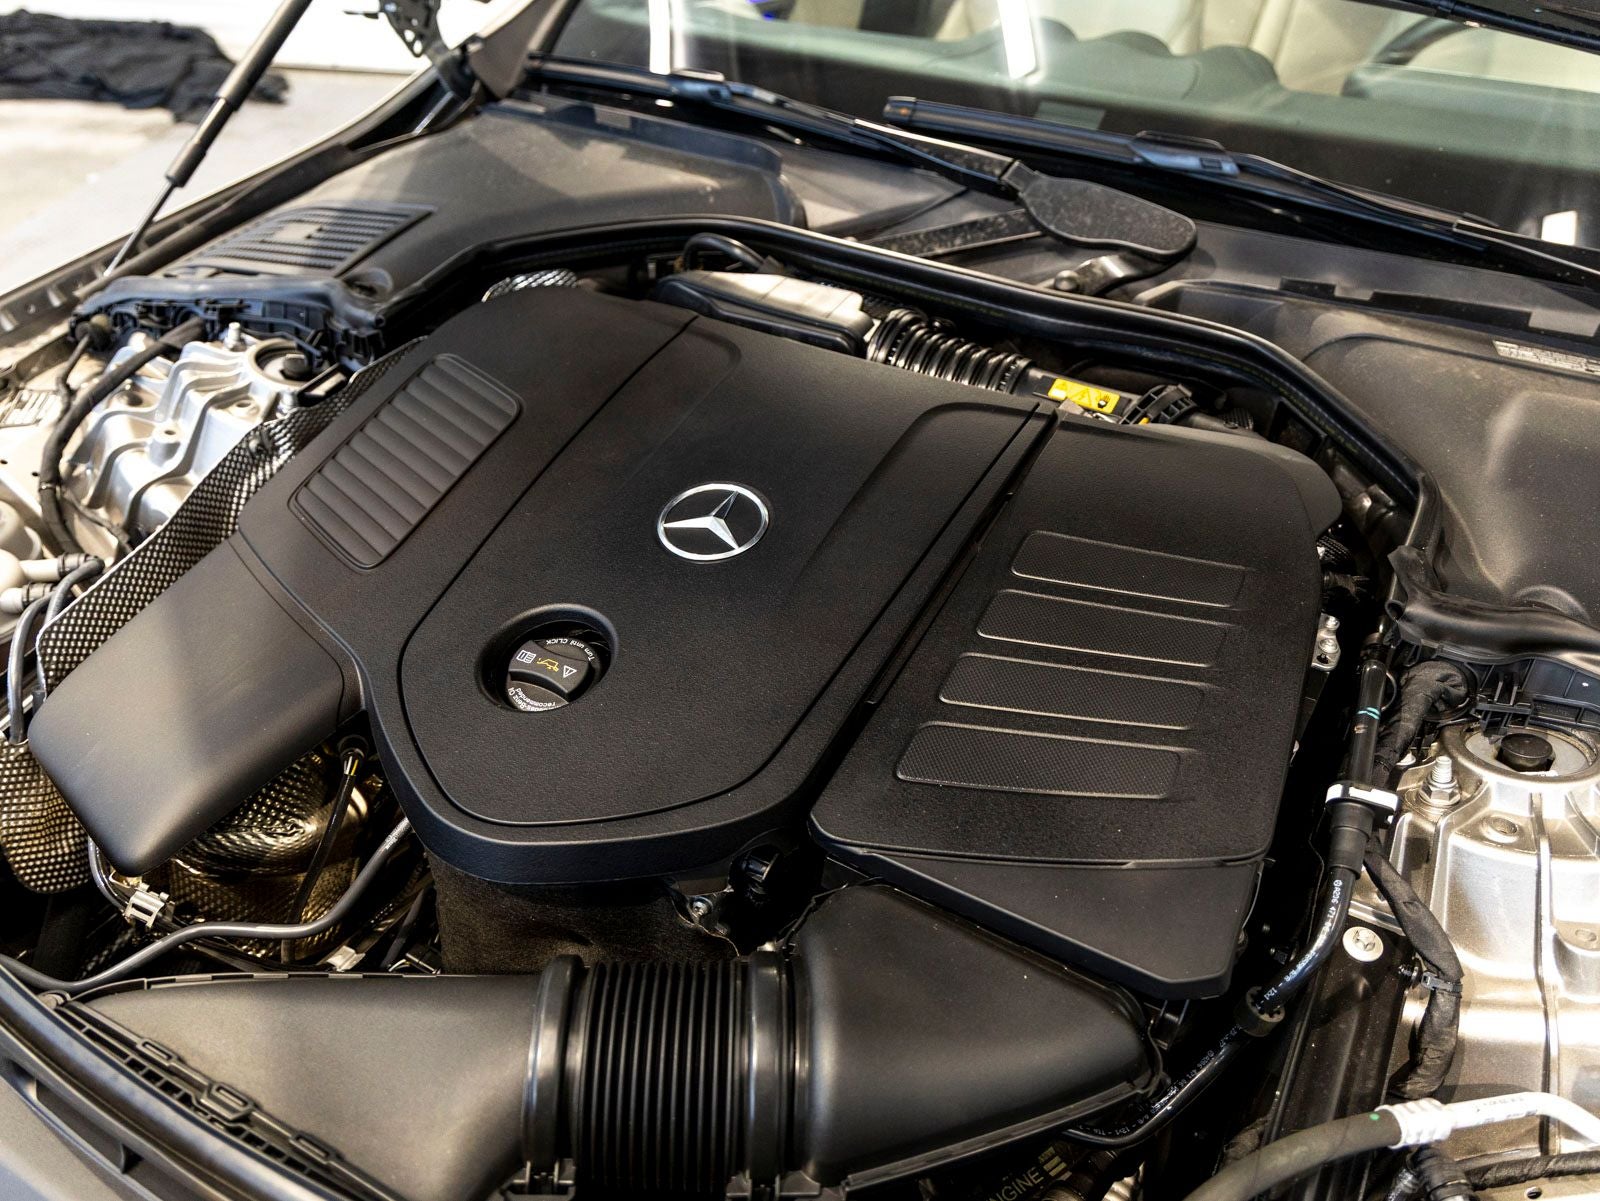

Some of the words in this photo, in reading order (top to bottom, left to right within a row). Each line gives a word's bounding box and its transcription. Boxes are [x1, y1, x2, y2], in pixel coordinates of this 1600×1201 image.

[570, 640, 585, 649] until
[584, 648, 595, 661] Turn
[515, 688, 556, 707] recommended
[987, 1166, 1045, 1201] NGINE
